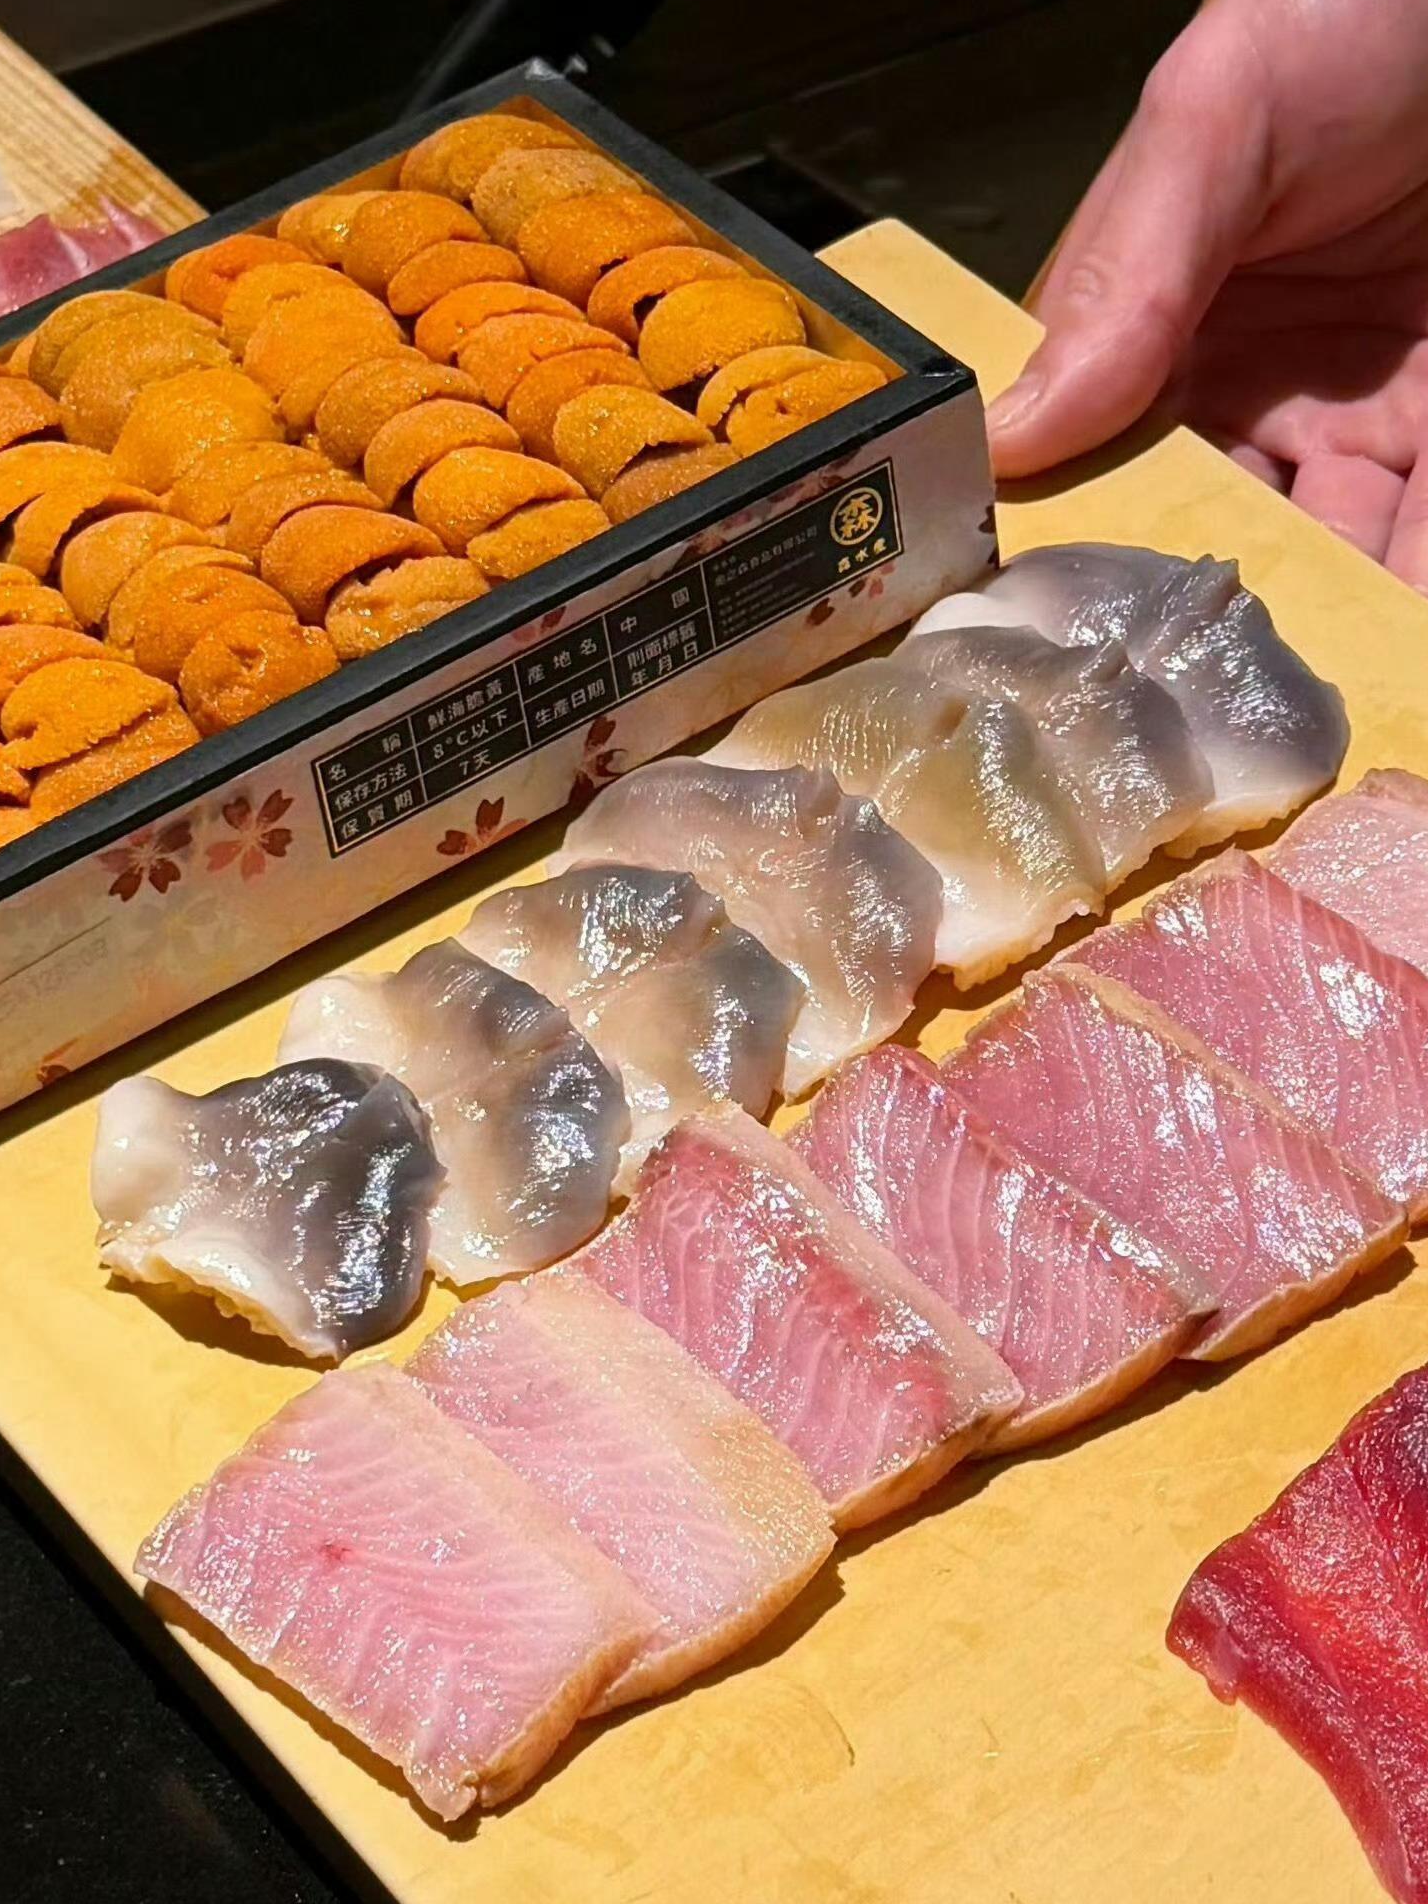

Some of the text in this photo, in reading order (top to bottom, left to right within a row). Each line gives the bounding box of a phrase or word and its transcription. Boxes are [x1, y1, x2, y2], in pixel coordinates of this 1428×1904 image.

[458, 749, 493, 776] 7天
[334, 763, 408, 811] 保存方法
